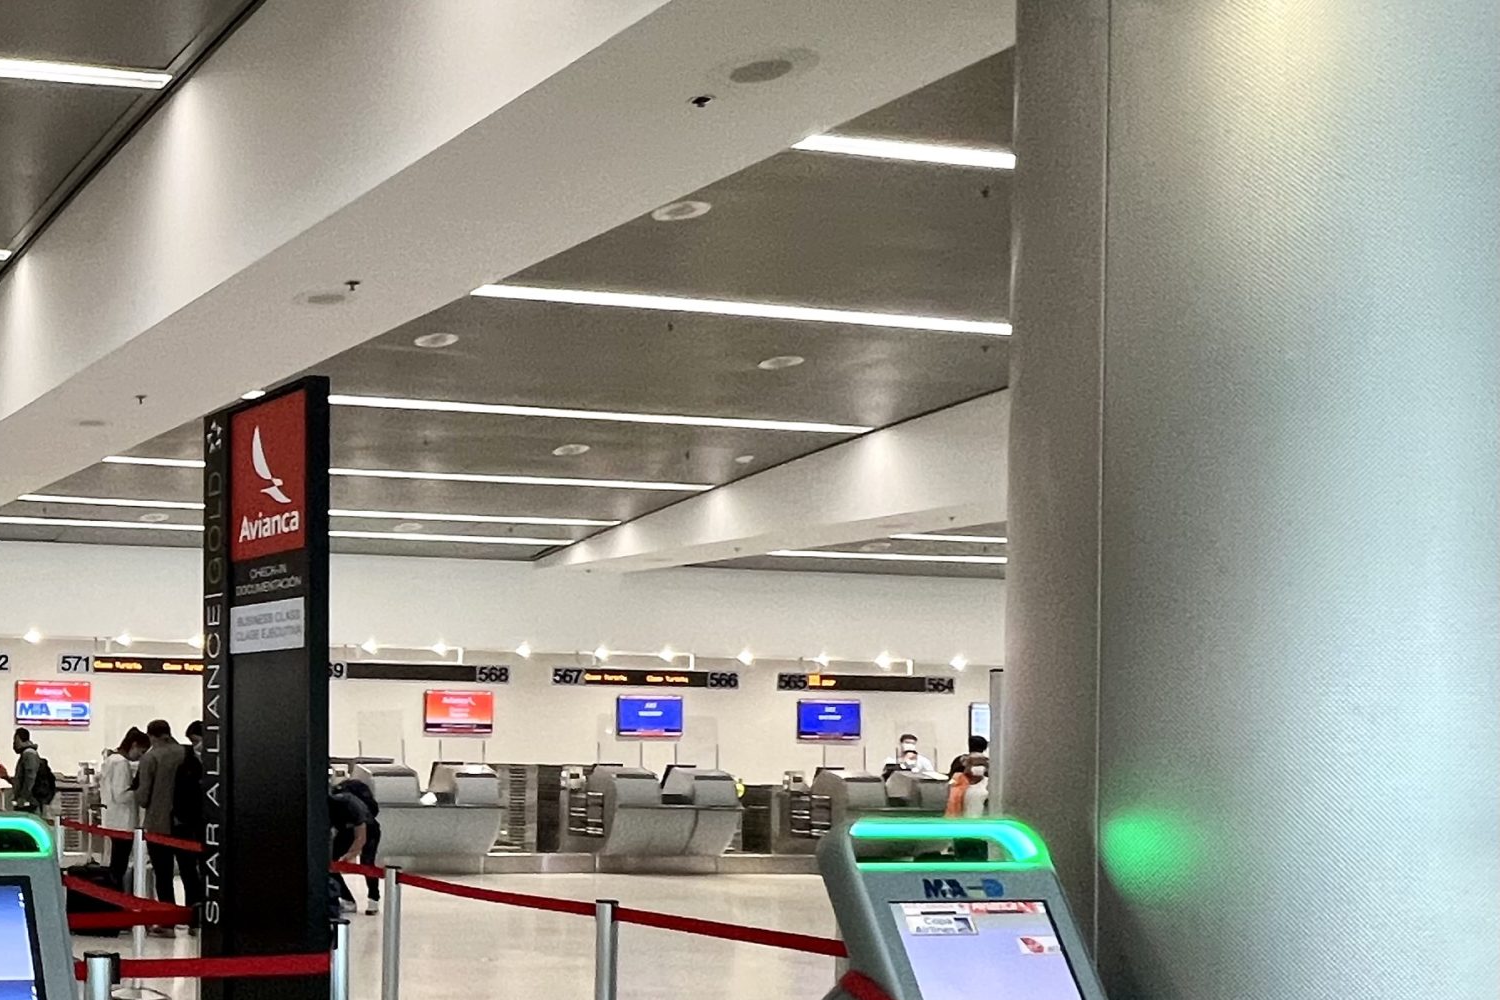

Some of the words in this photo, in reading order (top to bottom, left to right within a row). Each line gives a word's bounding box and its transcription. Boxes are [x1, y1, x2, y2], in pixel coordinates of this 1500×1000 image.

[207, 472, 222, 584] GOLD
[238, 509, 300, 543] Avianca
[61, 656, 90, 672] 571
[478, 666, 510, 683] 568
[553, 668, 583, 684] 567
[709, 672, 739, 688] 566
[778, 674, 808, 690] 565
[928, 677, 955, 693] 564
[206, 604, 221, 807] ALLIANCE
[205, 823, 220, 924] STAR
